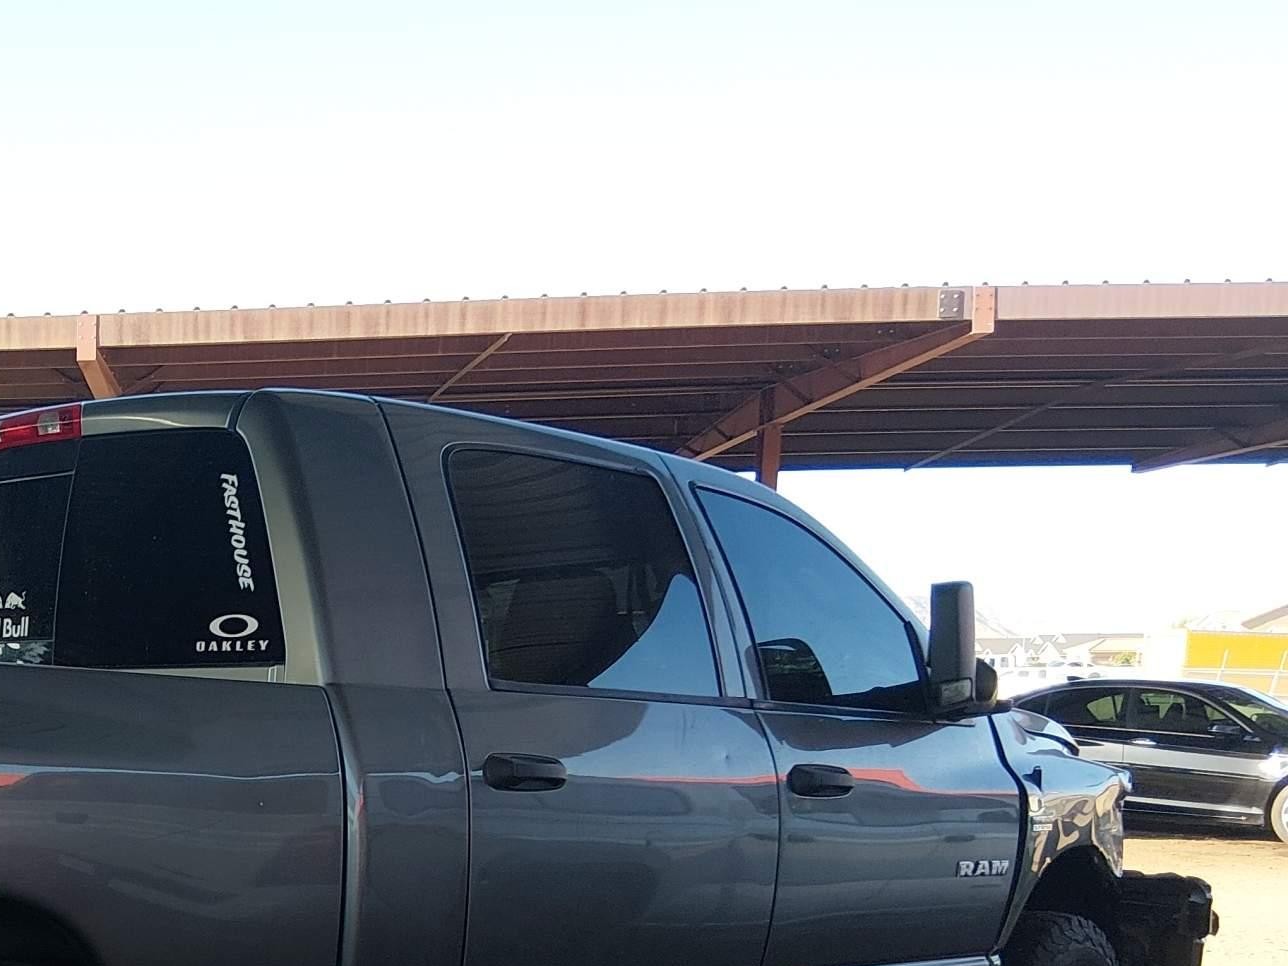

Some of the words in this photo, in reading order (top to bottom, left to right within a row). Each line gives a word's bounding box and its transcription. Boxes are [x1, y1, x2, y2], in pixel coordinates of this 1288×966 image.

[219, 472, 255, 592] FASTHOUSE
[2, 616, 29, 638] Bull
[195, 639, 270, 653] OAKLEY
[957, 859, 1009, 877] RAM
